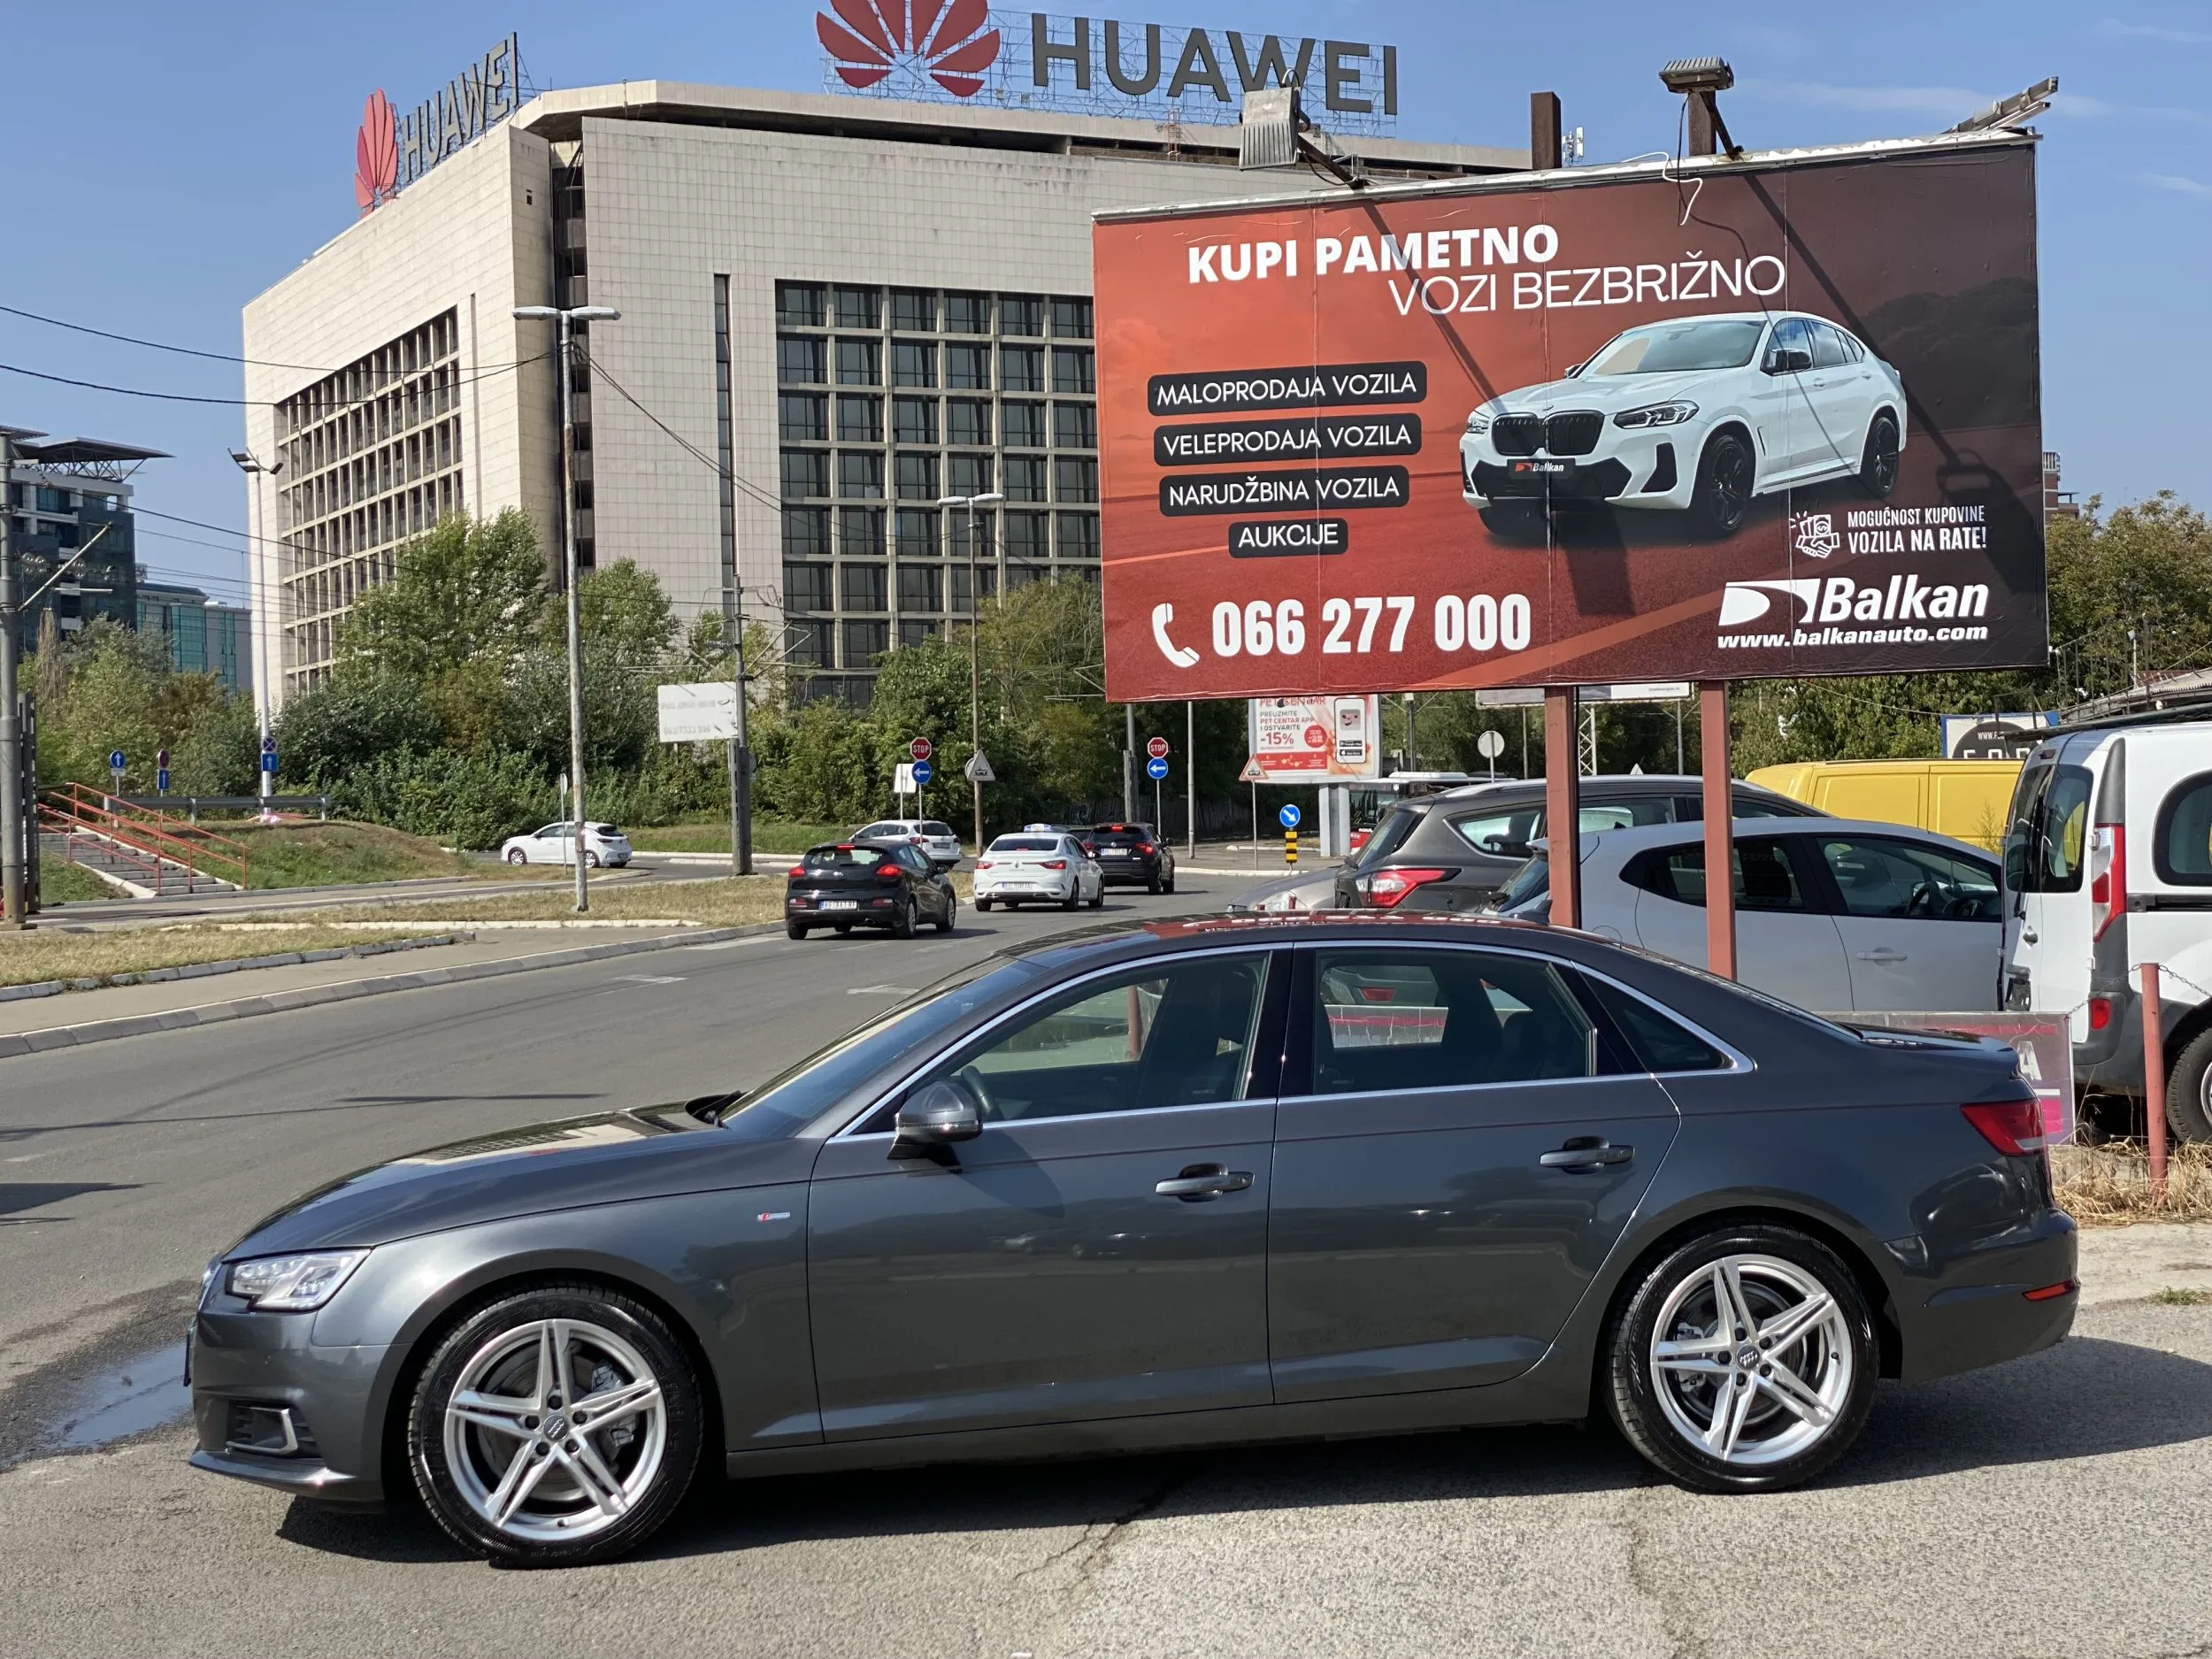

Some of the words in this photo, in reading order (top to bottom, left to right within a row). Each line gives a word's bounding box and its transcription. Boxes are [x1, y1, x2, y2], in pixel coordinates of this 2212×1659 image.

[1032, 13, 1397, 115] HUAWEI
[401, 32, 519, 183] HUAWEI
[1187, 240, 1297, 283] KUPI
[1317, 224, 1559, 276] PAMETNO
[1388, 274, 1496, 317] VOZI
[1513, 250, 1786, 310] BEZBRIŽNO
[1156, 375, 1325, 406] MALOPRODAJA
[1332, 372, 1417, 396] VOZILA
[1163, 427, 1321, 457] VELEPRODAJA
[1327, 424, 1411, 449] VOZILA
[1169, 475, 1310, 507] NARUDŽBINA
[1315, 476, 1400, 501] VOZILA
[1847, 505, 1921, 529] MOGUĆNOST
[1924, 504, 1985, 525] KUPOVINE
[1238, 523, 1339, 548] AUKCIJE
[1847, 530, 1904, 555] VOZILA
[1910, 528, 1935, 552] NA
[1939, 526, 1987, 550] RATE!
[1818, 574, 1990, 623] Balkan
[1212, 599, 1306, 658] 066
[1322, 595, 1415, 654] 277
[1434, 594, 1531, 651] 000
[1717, 625, 1988, 649] www.balkanauto.com
[912, 744, 929, 754] STOP
[1150, 743, 1166, 753] STOP
[1260, 732, 1294, 745] -15%
